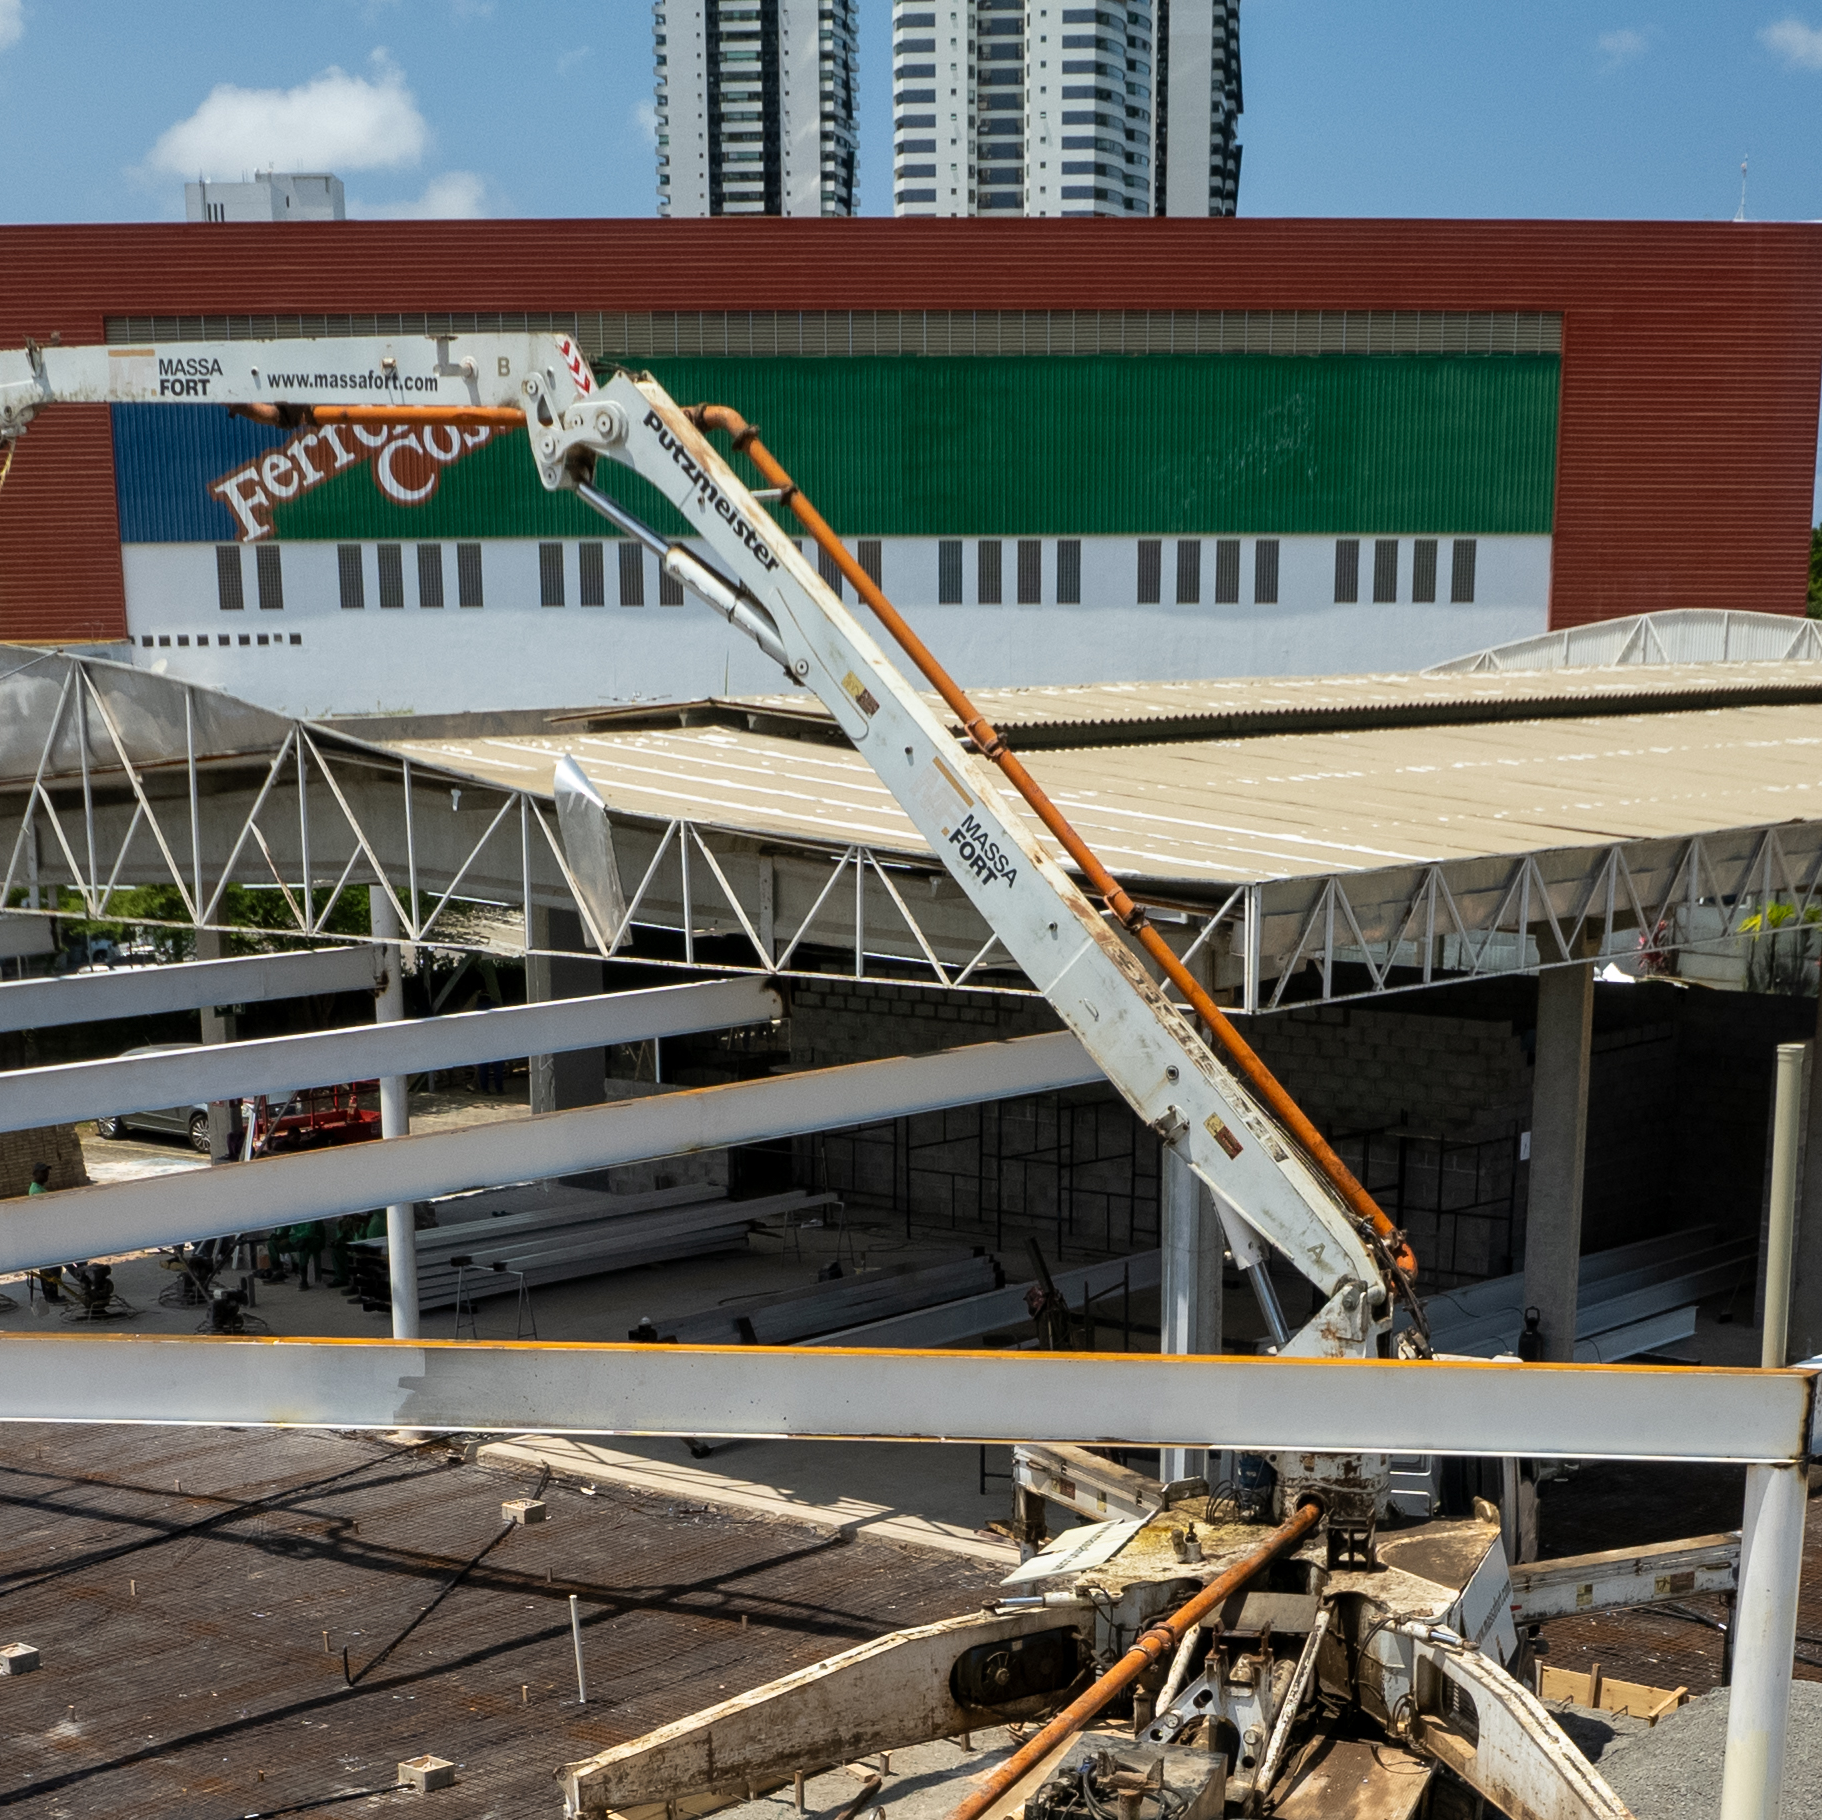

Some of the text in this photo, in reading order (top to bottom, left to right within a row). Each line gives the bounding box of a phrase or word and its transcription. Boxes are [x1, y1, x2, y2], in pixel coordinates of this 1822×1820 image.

[159, 358, 223, 376] MASSA
[497, 357, 511, 377] B
[160, 378, 210, 396] FORT
[268, 370, 439, 392] www.massafort.com
[948, 827, 998, 886] FORT
[961, 813, 1018, 889] MASSA
